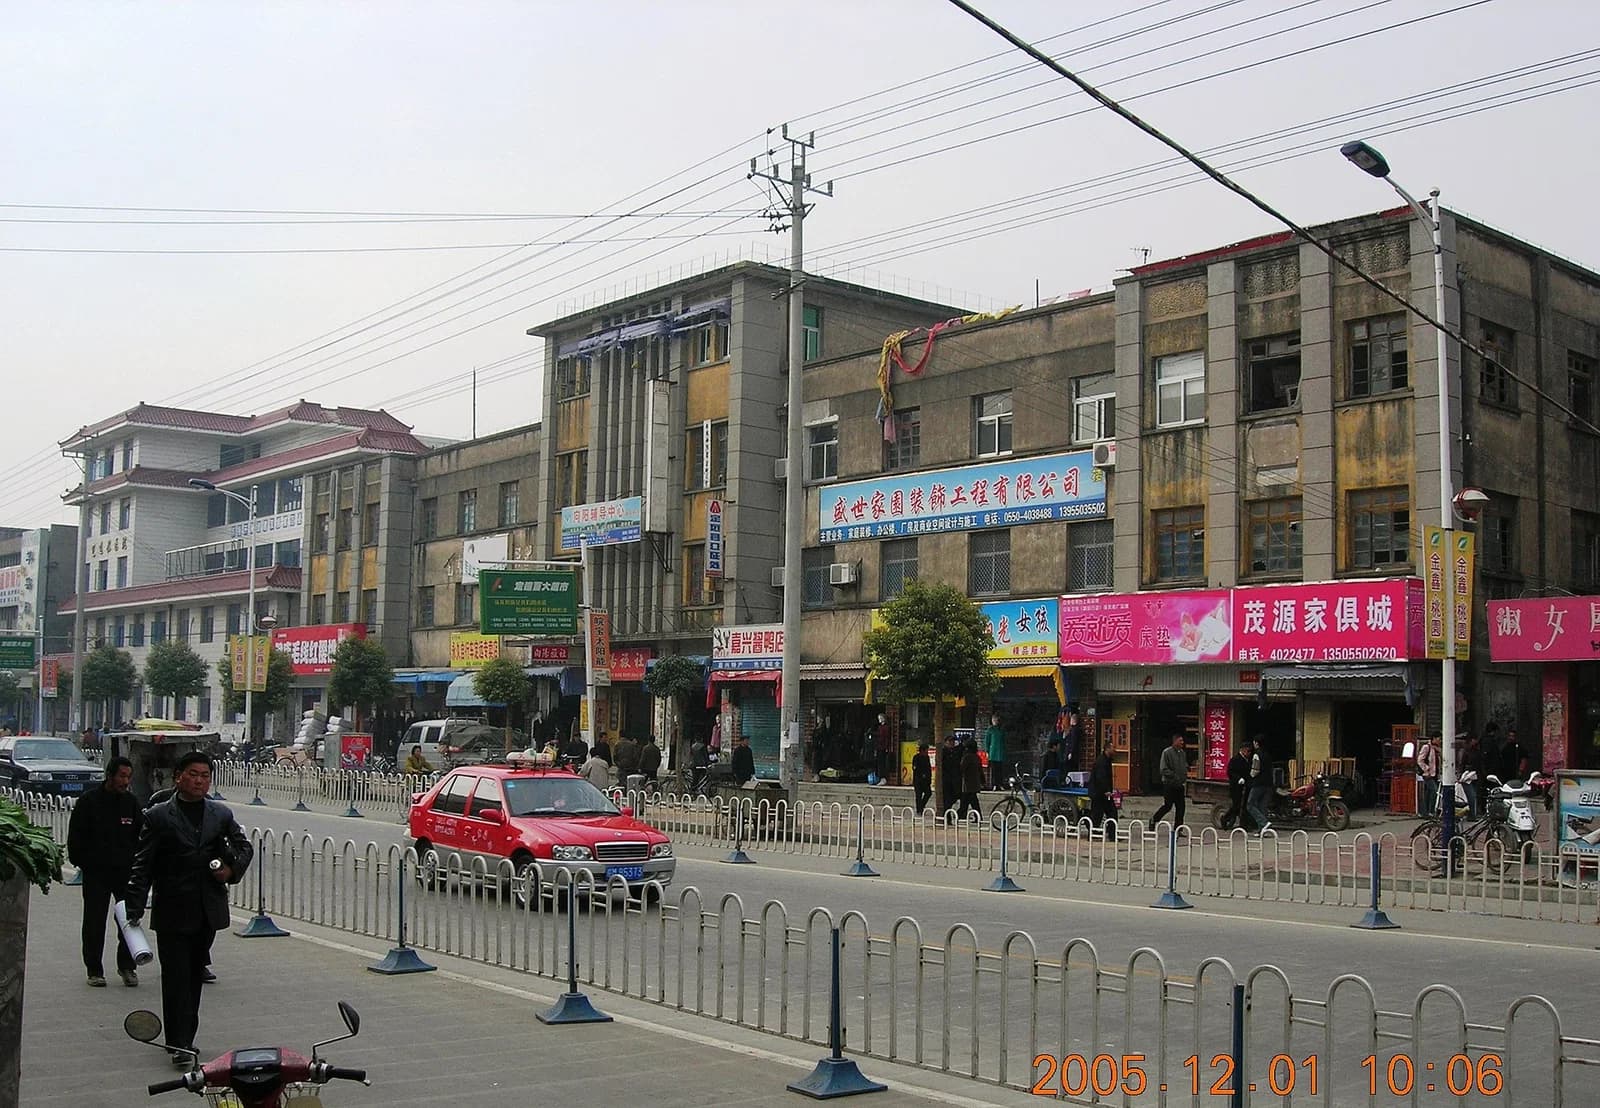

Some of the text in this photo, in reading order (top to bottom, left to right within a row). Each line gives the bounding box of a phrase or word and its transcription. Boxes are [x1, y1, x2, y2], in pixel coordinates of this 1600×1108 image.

[1243, 595, 1393, 635] 茂源家俱城
[731, 631, 784, 654] 嘉兴酱鸭店
[1063, 611, 1170, 654] 爱就爱 床垫
[1323, 647, 1396, 660] 13505502620
